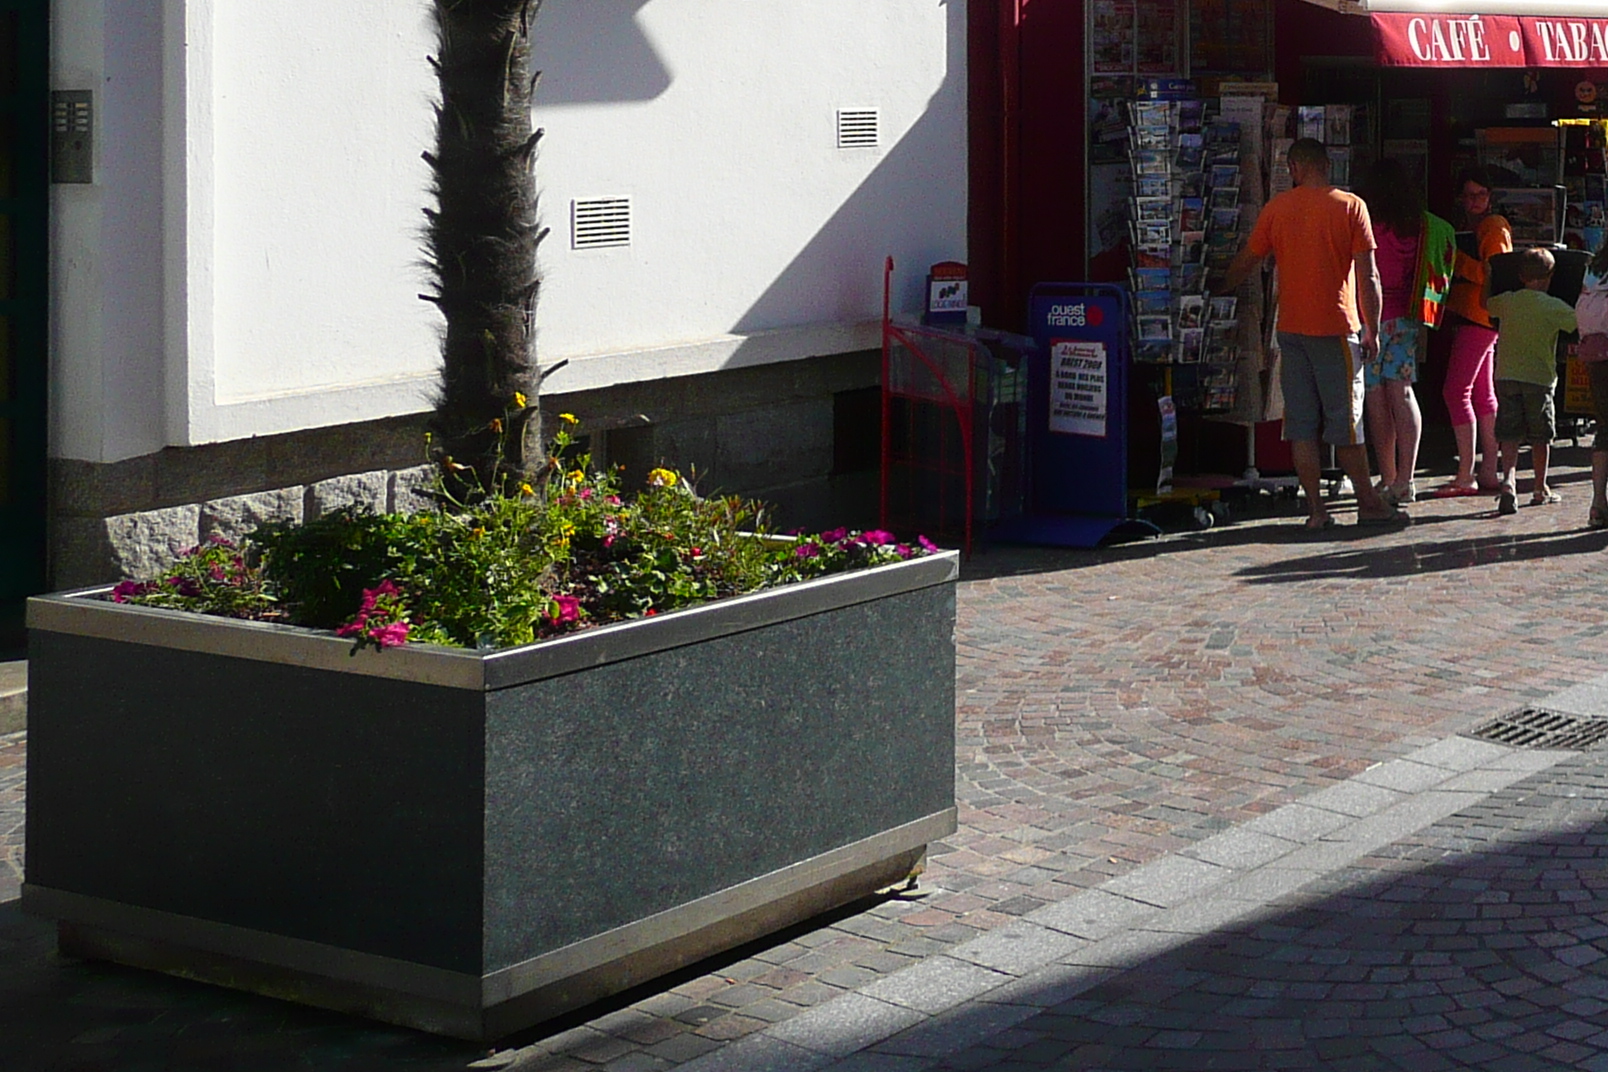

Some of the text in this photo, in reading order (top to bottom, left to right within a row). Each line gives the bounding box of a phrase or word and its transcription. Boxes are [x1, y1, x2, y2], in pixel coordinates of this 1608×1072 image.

[1408, 14, 1490, 61] CAFÉ
[1051, 303, 1085, 316] ouest
[1047, 312, 1086, 326] france
